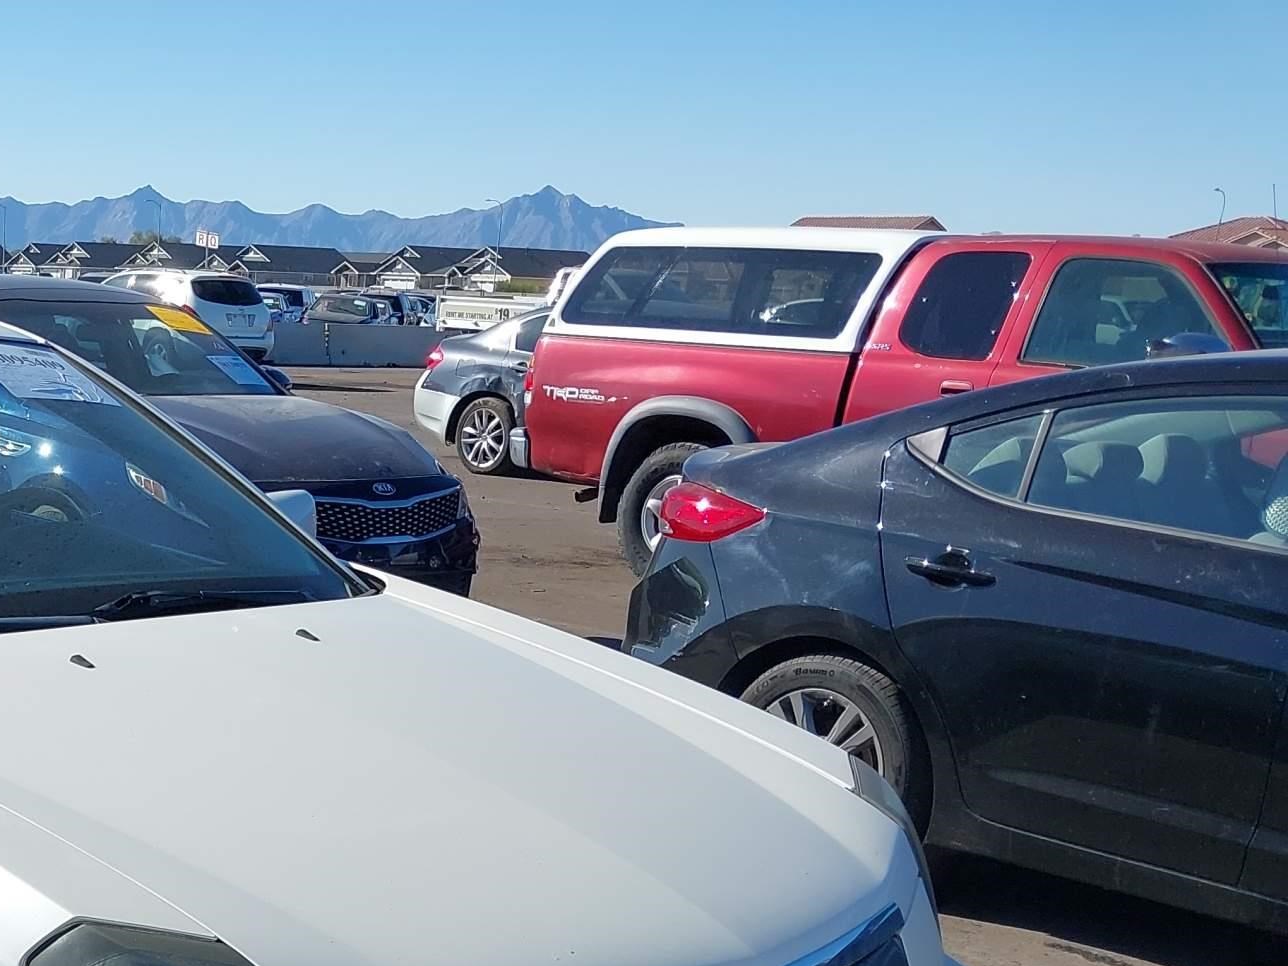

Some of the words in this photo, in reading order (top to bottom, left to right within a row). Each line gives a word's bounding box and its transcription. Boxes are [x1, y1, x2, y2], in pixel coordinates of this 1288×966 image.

[465, 312, 486, 320] STARTING
[494, 307, 510, 320] $19
[542, 385, 579, 402] TRD
